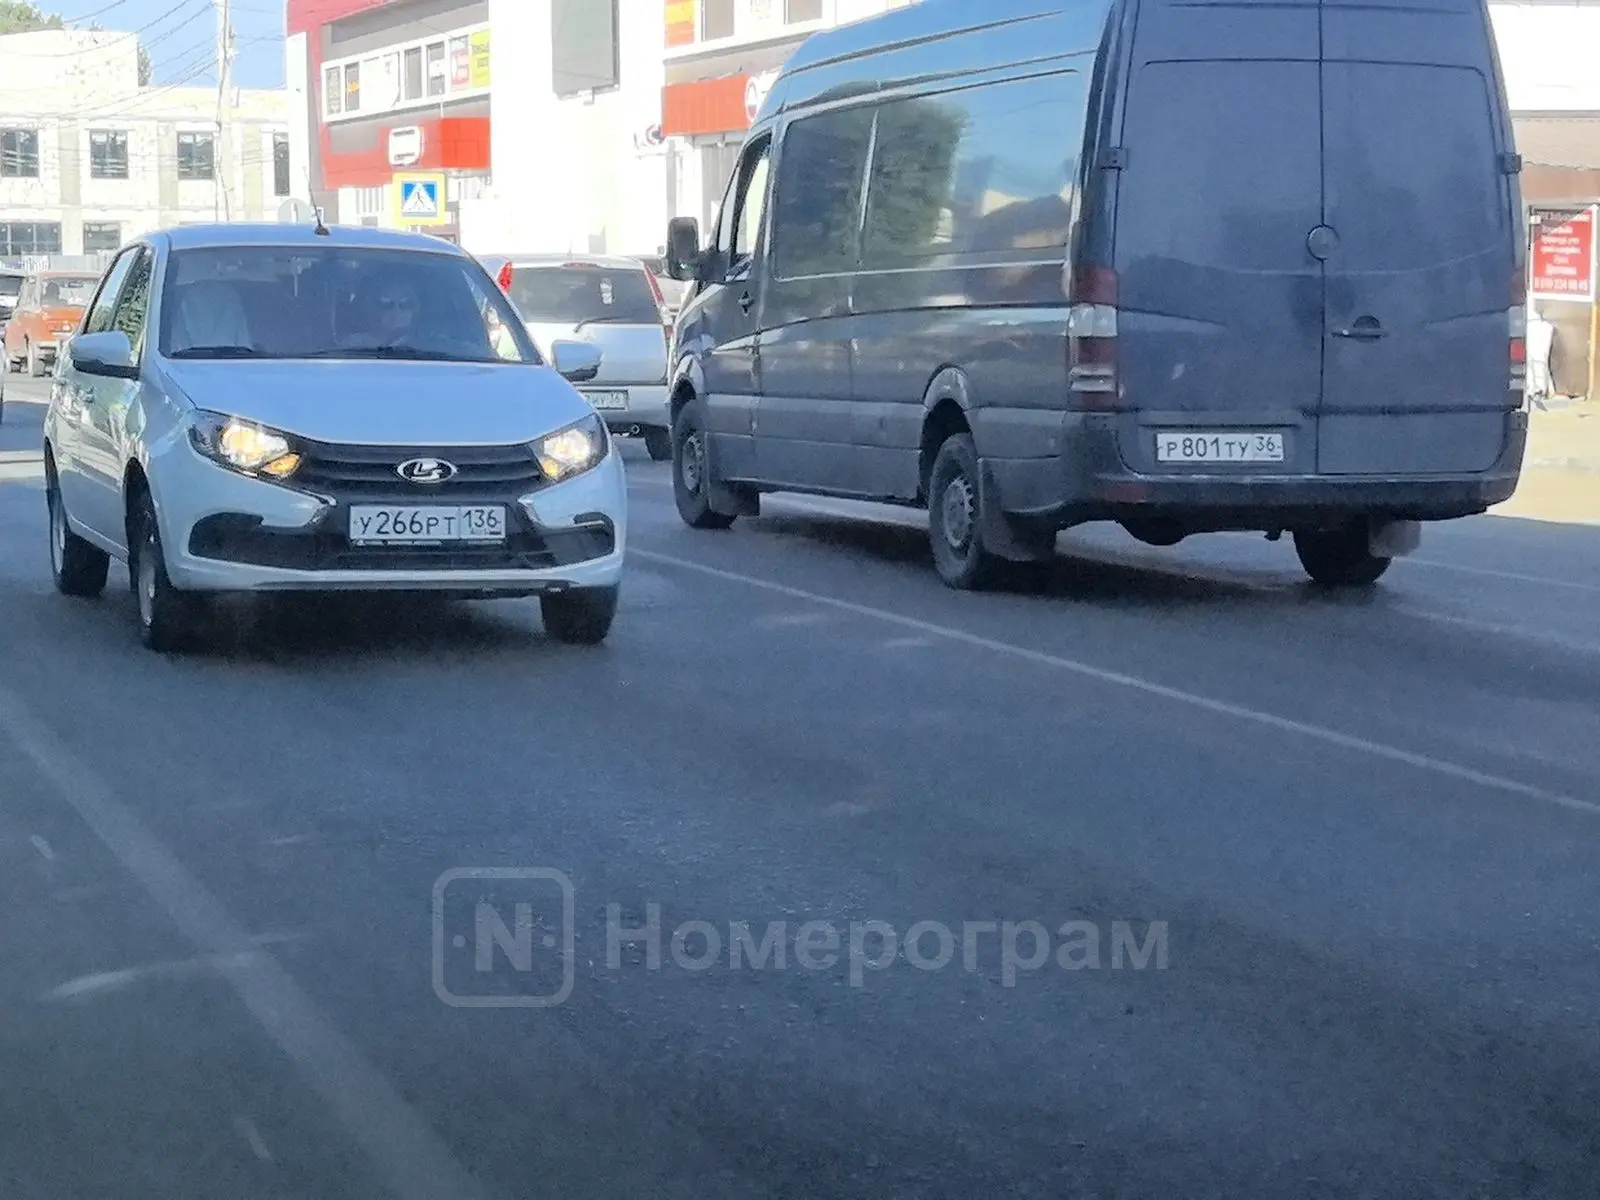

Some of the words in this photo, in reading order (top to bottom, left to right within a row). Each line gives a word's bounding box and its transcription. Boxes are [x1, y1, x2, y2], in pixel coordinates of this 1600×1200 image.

[1255, 436, 1276, 452] 36
[359, 511, 456, 535] У266РТ
[463, 509, 498, 529] 136
